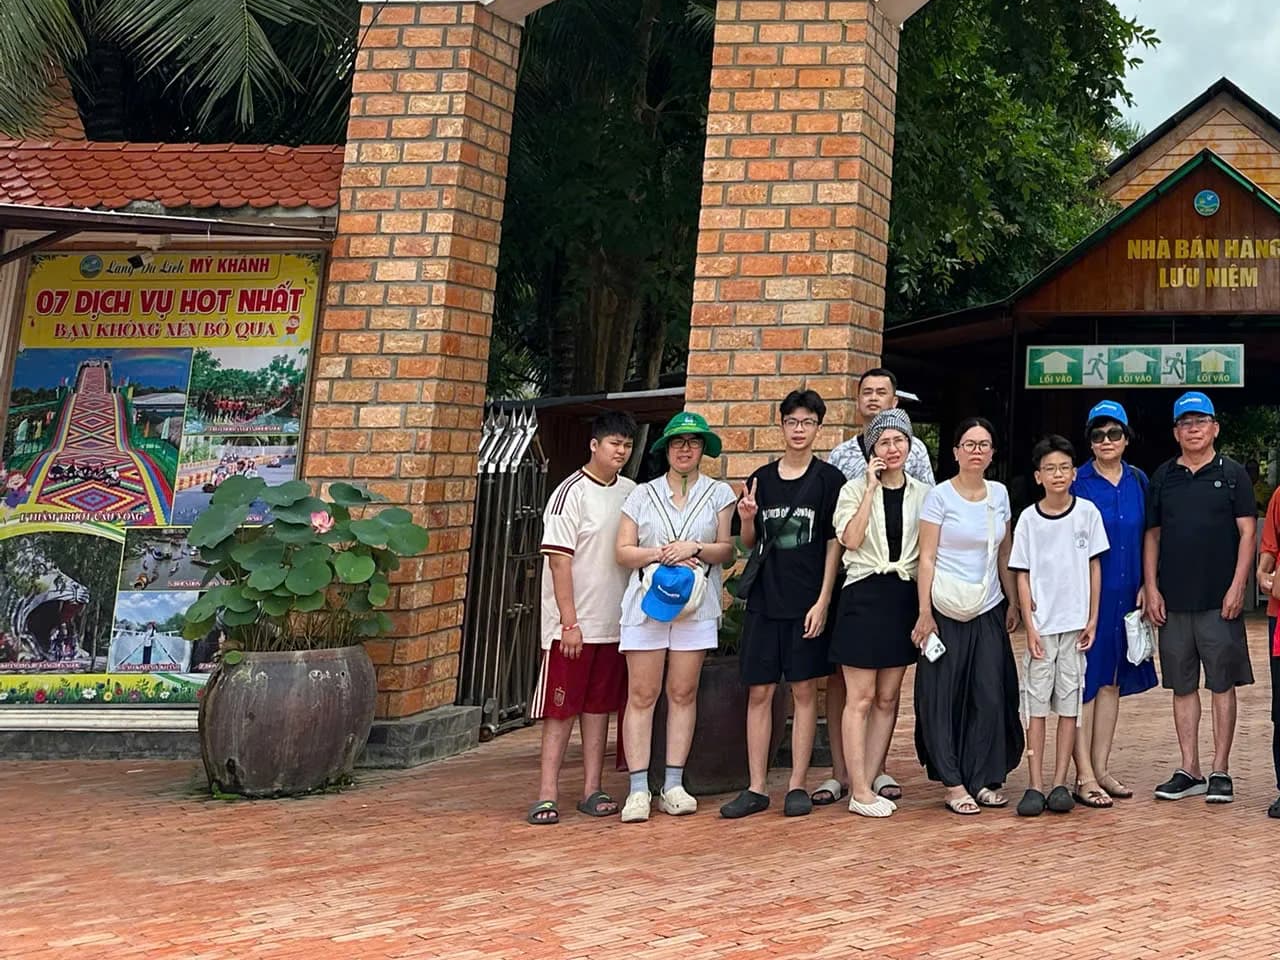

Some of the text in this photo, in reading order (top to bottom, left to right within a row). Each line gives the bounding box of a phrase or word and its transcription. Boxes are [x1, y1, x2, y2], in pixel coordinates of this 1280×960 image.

[1127, 236, 1171, 260] NHÀ
[1175, 235, 1219, 259] BÁN
[217, 255, 270, 273] KHÁNH
[1159, 264, 1258, 291] LƯU NIỆM
[36, 280, 305, 320] 07 DỊCH VỤ HOT NHẤT
[55, 322, 92, 341] BẠN
[96, 319, 161, 338] KHÔNG
[235, 321, 277, 340] QUA
